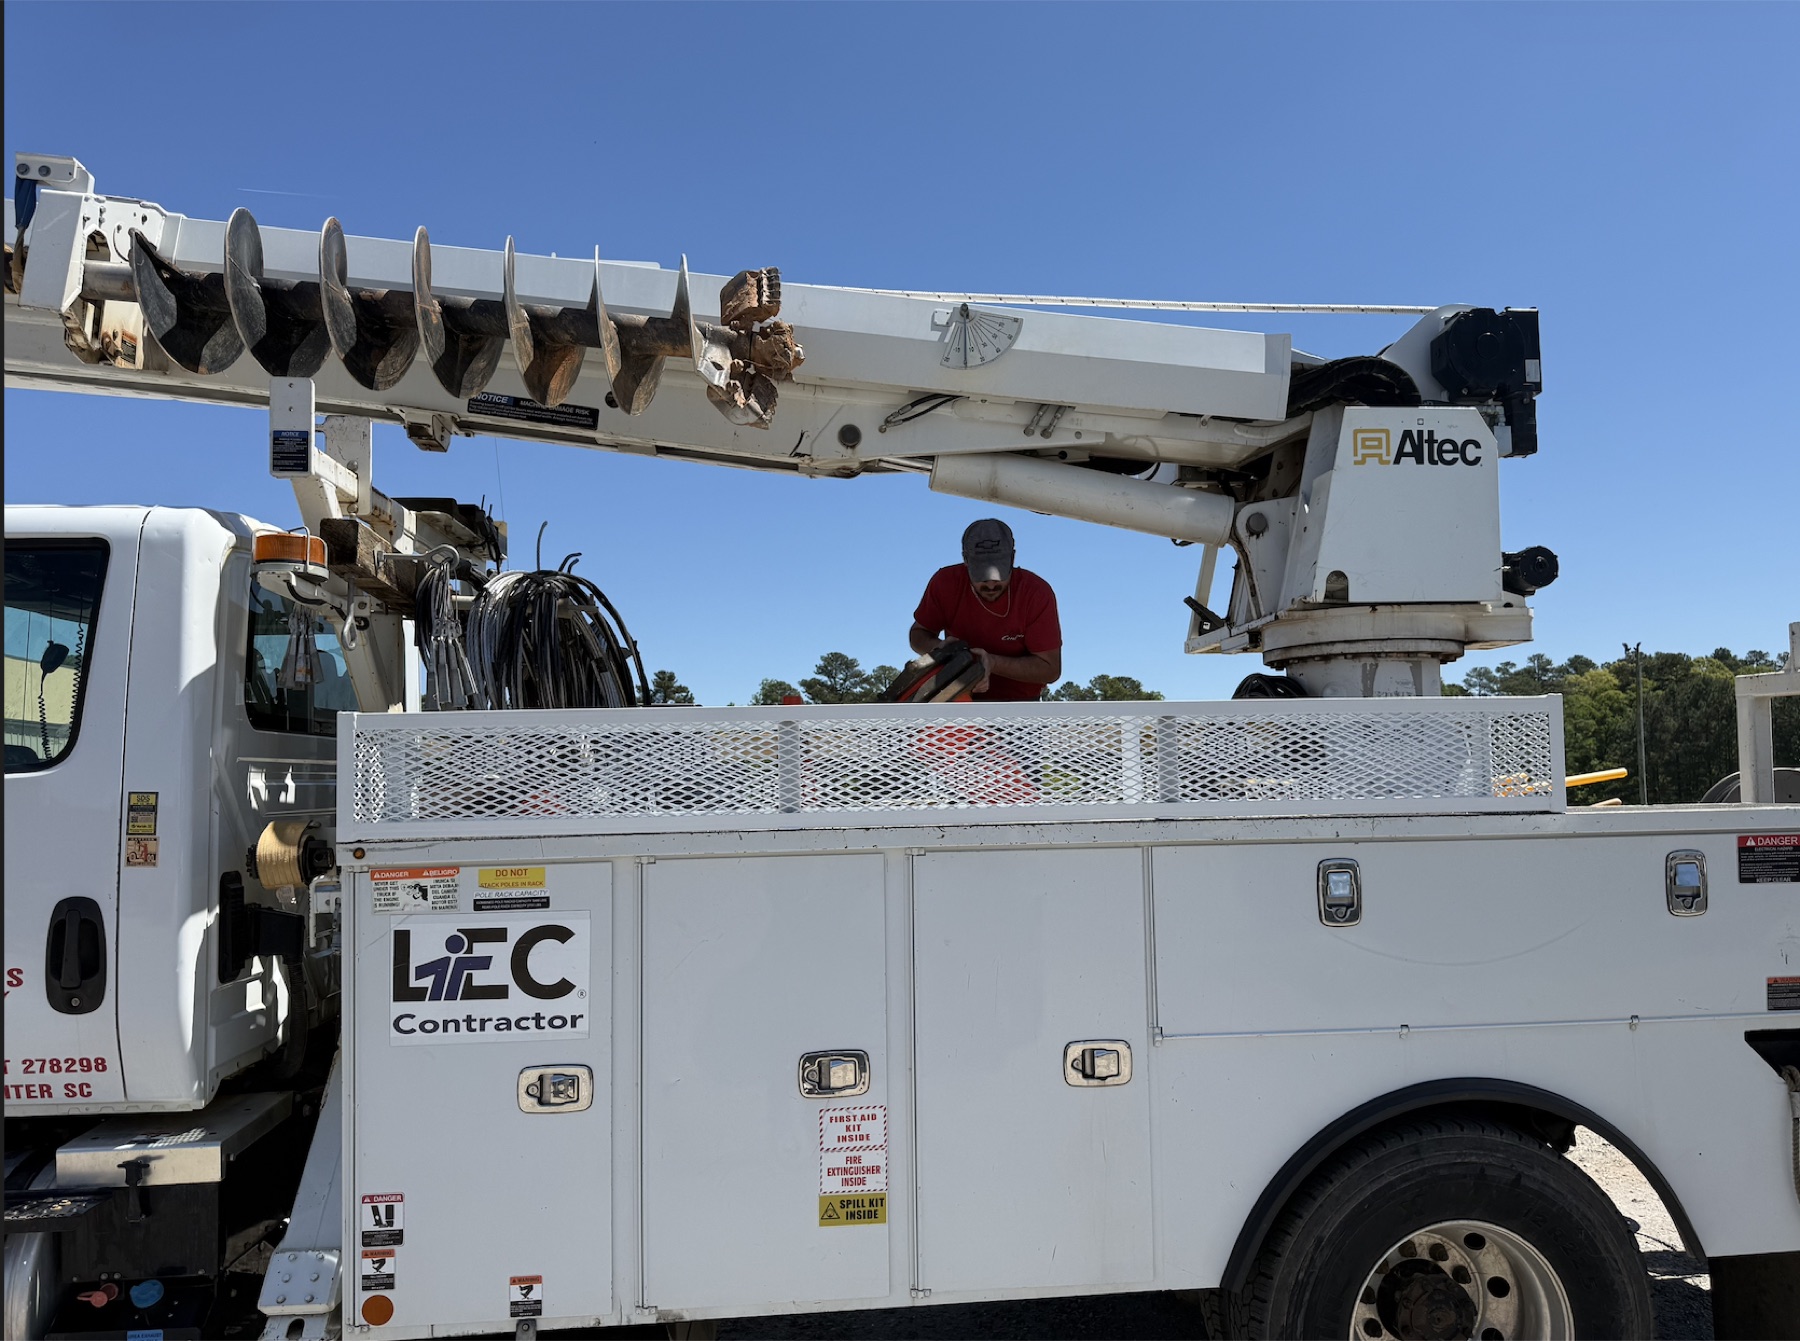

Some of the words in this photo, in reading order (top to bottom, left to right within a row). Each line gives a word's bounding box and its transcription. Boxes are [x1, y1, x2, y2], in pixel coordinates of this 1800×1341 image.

[474, 393, 509, 404] NOTICE
[575, 407, 590, 415] RISK
[1392, 429, 1481, 467] Altec
[136, 793, 151, 802] SDS
[1757, 836, 1799, 846] DANGER
[495, 869, 508, 877] DO
[510, 868, 528, 877] NOT
[514, 889, 548, 897] CAPACITY
[392, 1012, 584, 1035] Contractor
[21, 1057, 108, 1075] 278298
[63, 1082, 93, 1098] SC
[829, 1114, 857, 1123] FIRST
[860, 1113, 877, 1121] AID
[845, 1123, 862, 1133] KIT
[837, 1133, 871, 1143] INSIDE
[845, 1156, 862, 1165] FIRE
[827, 1165, 881, 1177] EXTINGUISHER
[841, 1177, 867, 1187] INSIDE
[839, 1199, 866, 1209] SPILL
[868, 1197, 885, 1208] KIT
[845, 1209, 879, 1221] INSIDE
